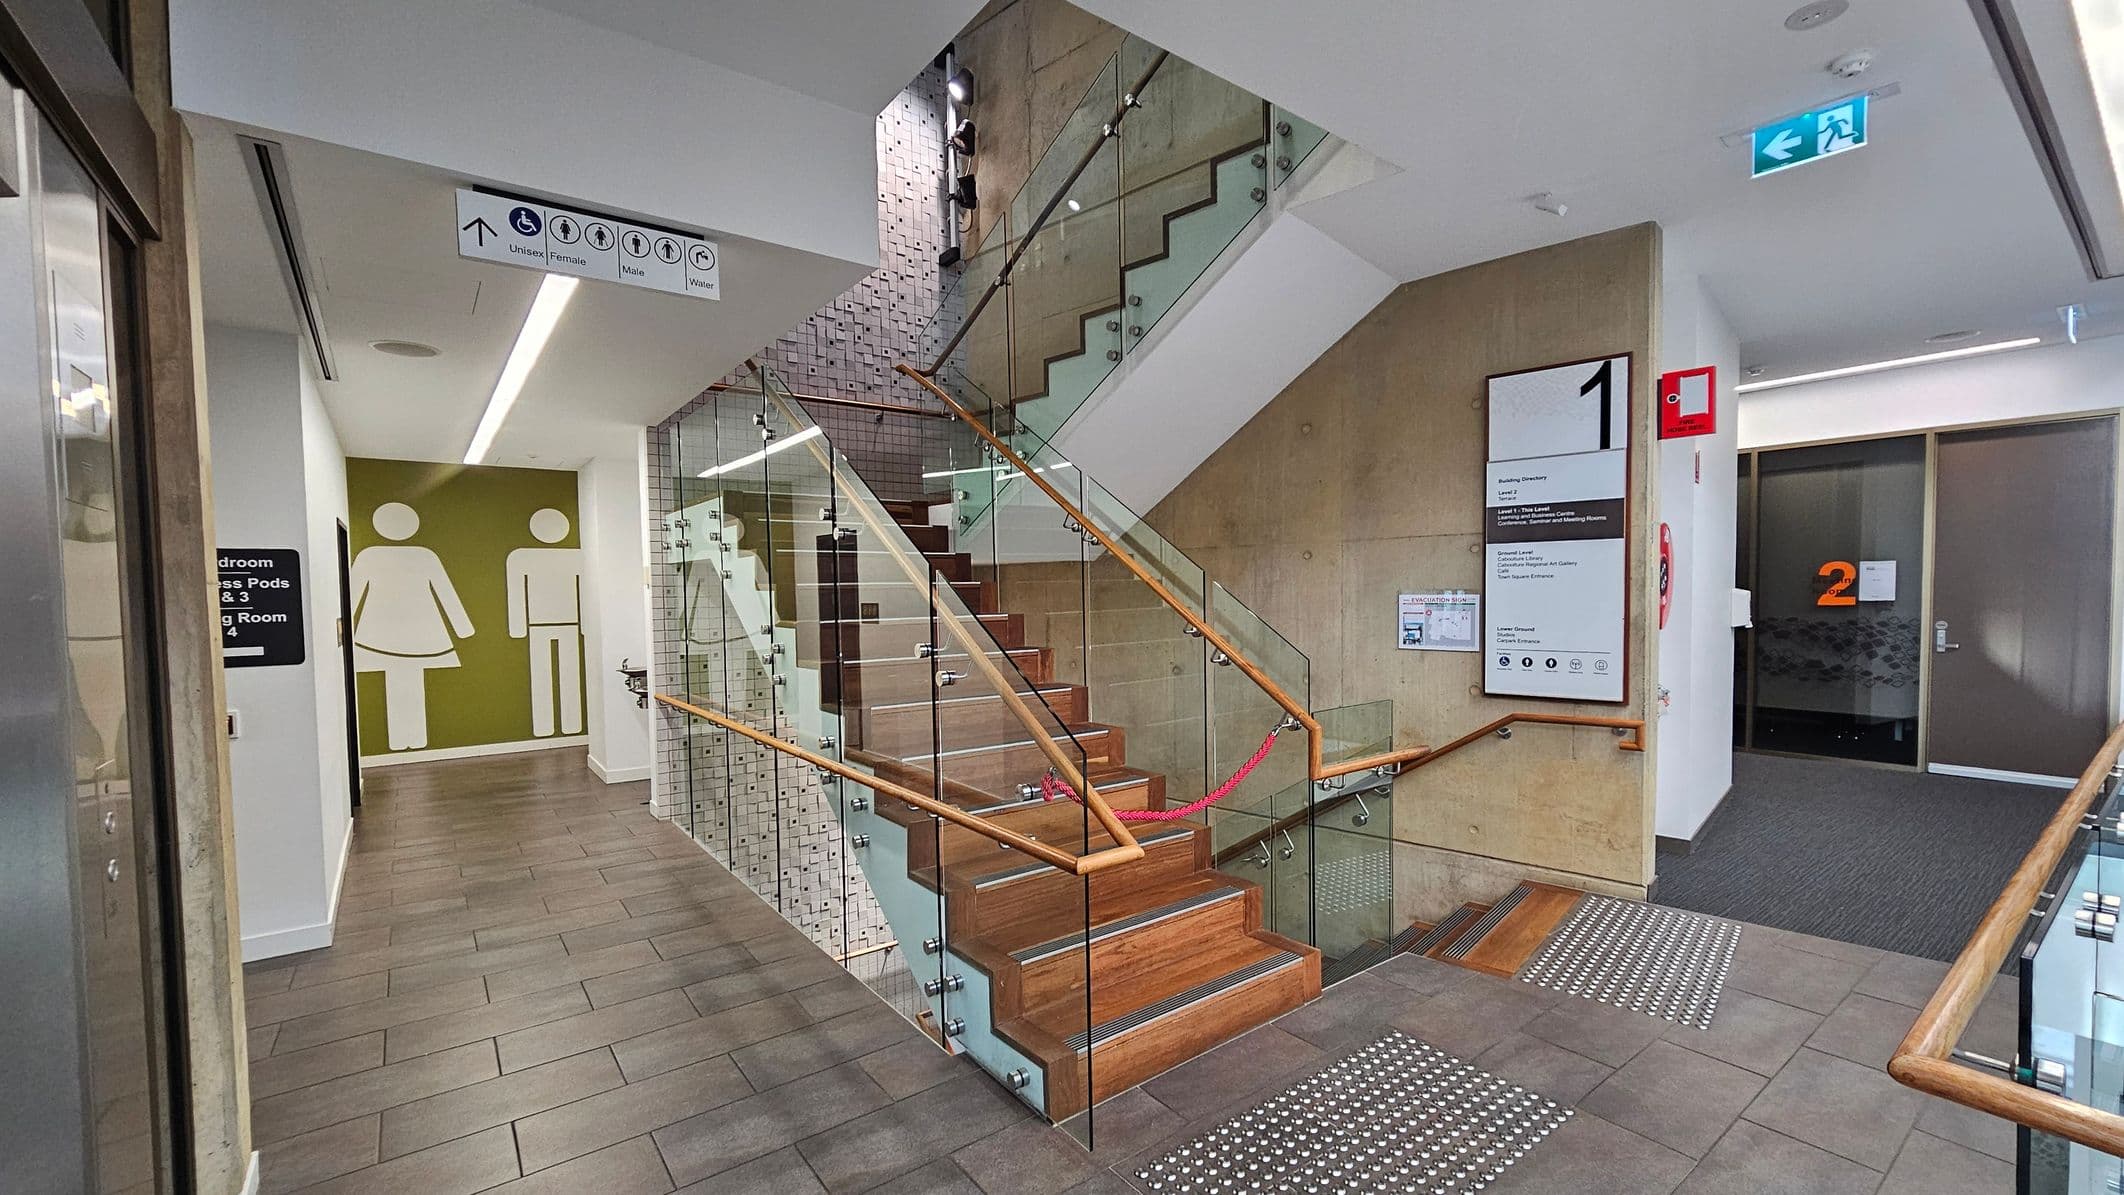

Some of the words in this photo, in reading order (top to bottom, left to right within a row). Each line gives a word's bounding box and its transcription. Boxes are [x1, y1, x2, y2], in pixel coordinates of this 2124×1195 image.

[509, 244, 545, 259] Unisex
[550, 251, 587, 267] Female
[622, 264, 645, 278] Male
[689, 277, 715, 291] Water
[1580, 360, 1612, 450] 1
[218, 556, 274, 568] droom
[247, 578, 290, 589] Pods
[1818, 561, 1856, 605] 2
[221, 591, 235, 602] &
[239, 591, 250, 602] 3
[237, 612, 287, 623] Room
[227, 626, 238, 637] 4
